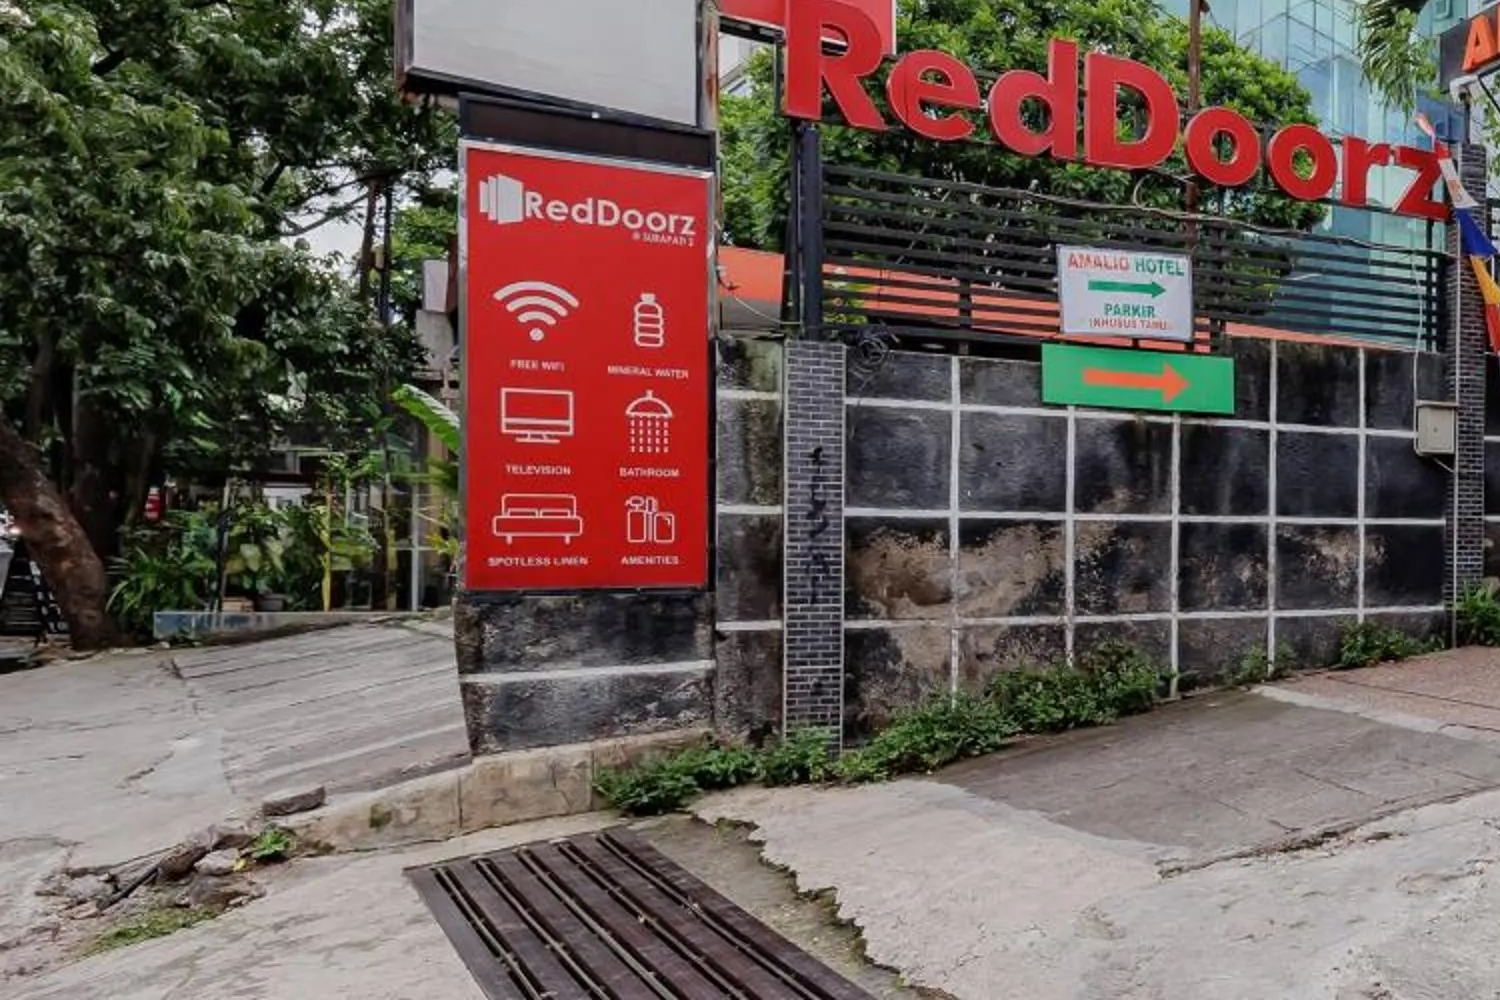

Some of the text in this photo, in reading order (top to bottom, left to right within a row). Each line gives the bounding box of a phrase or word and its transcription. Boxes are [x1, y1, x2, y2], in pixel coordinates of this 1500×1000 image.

[525, 191, 696, 235] RedDoorz
[1068, 252, 1185, 276] AMALIO HOTEL
[1104, 303, 1156, 318] PARKIR
[510, 359, 566, 372] FREE WIFI
[607, 364, 689, 379] MINERAL WATER
[506, 464, 571, 476] TELEVISION
[619, 466, 680, 478] BATHROOM
[487, 555, 589, 567] SPOTLESS LINEN
[620, 555, 680, 565] AMENITIES
